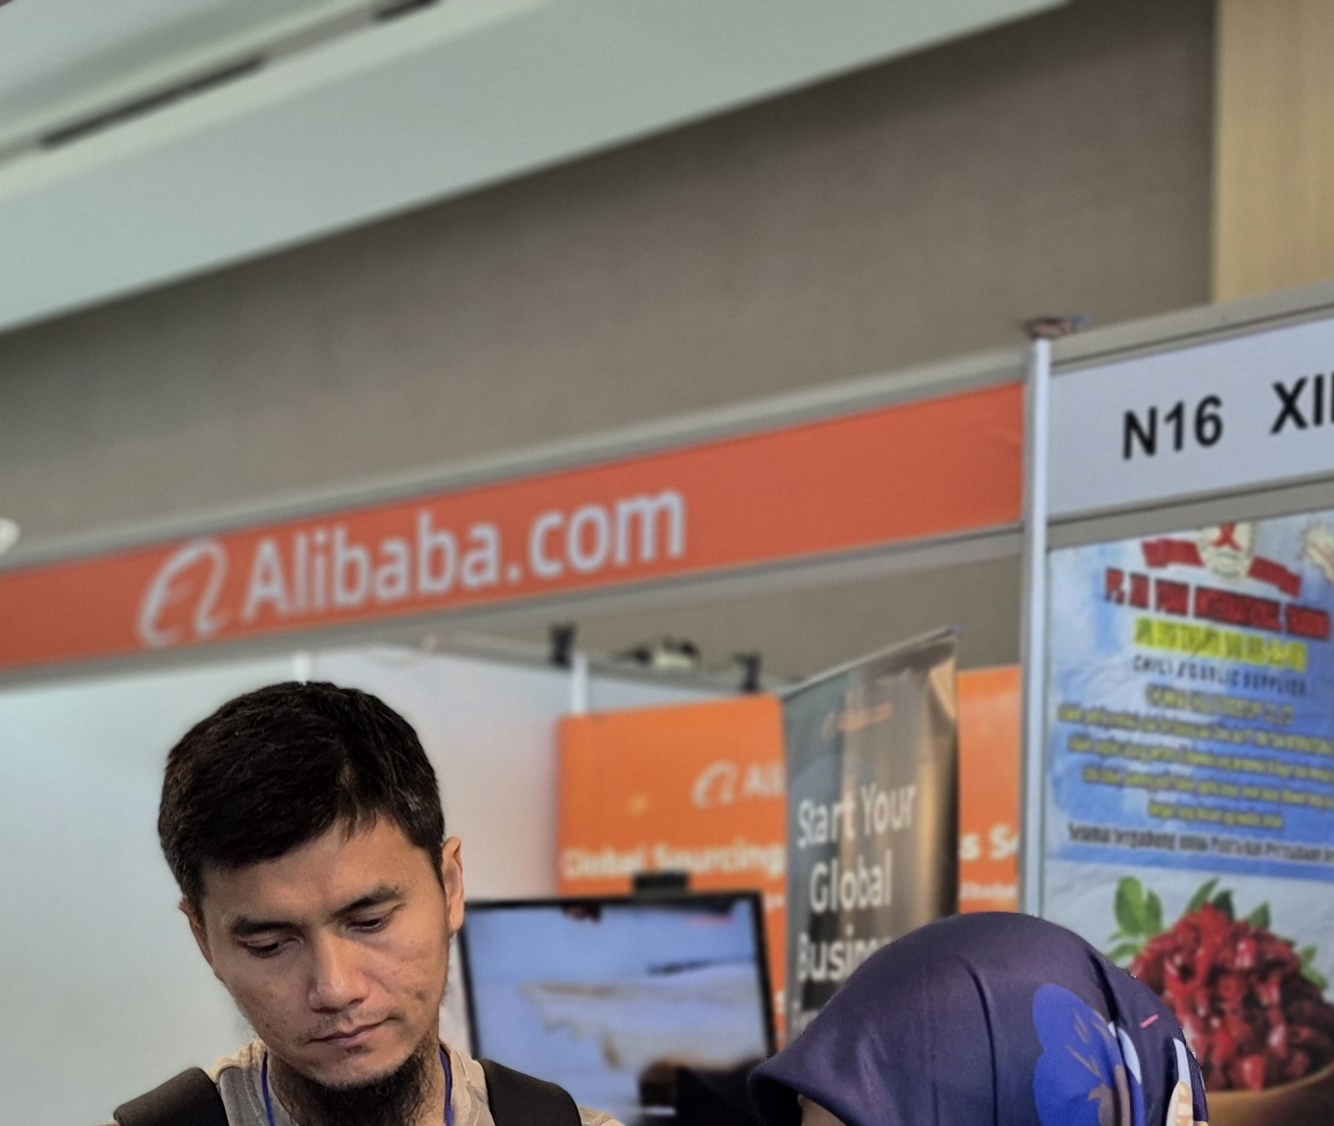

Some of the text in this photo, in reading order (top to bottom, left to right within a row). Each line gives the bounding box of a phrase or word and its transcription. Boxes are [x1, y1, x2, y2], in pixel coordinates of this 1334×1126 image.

[1120, 396, 1224, 461] N16
[241, 489, 688, 624] Alibaba.com
[797, 781, 918, 850] Start Your
[809, 848, 894, 915] Global
